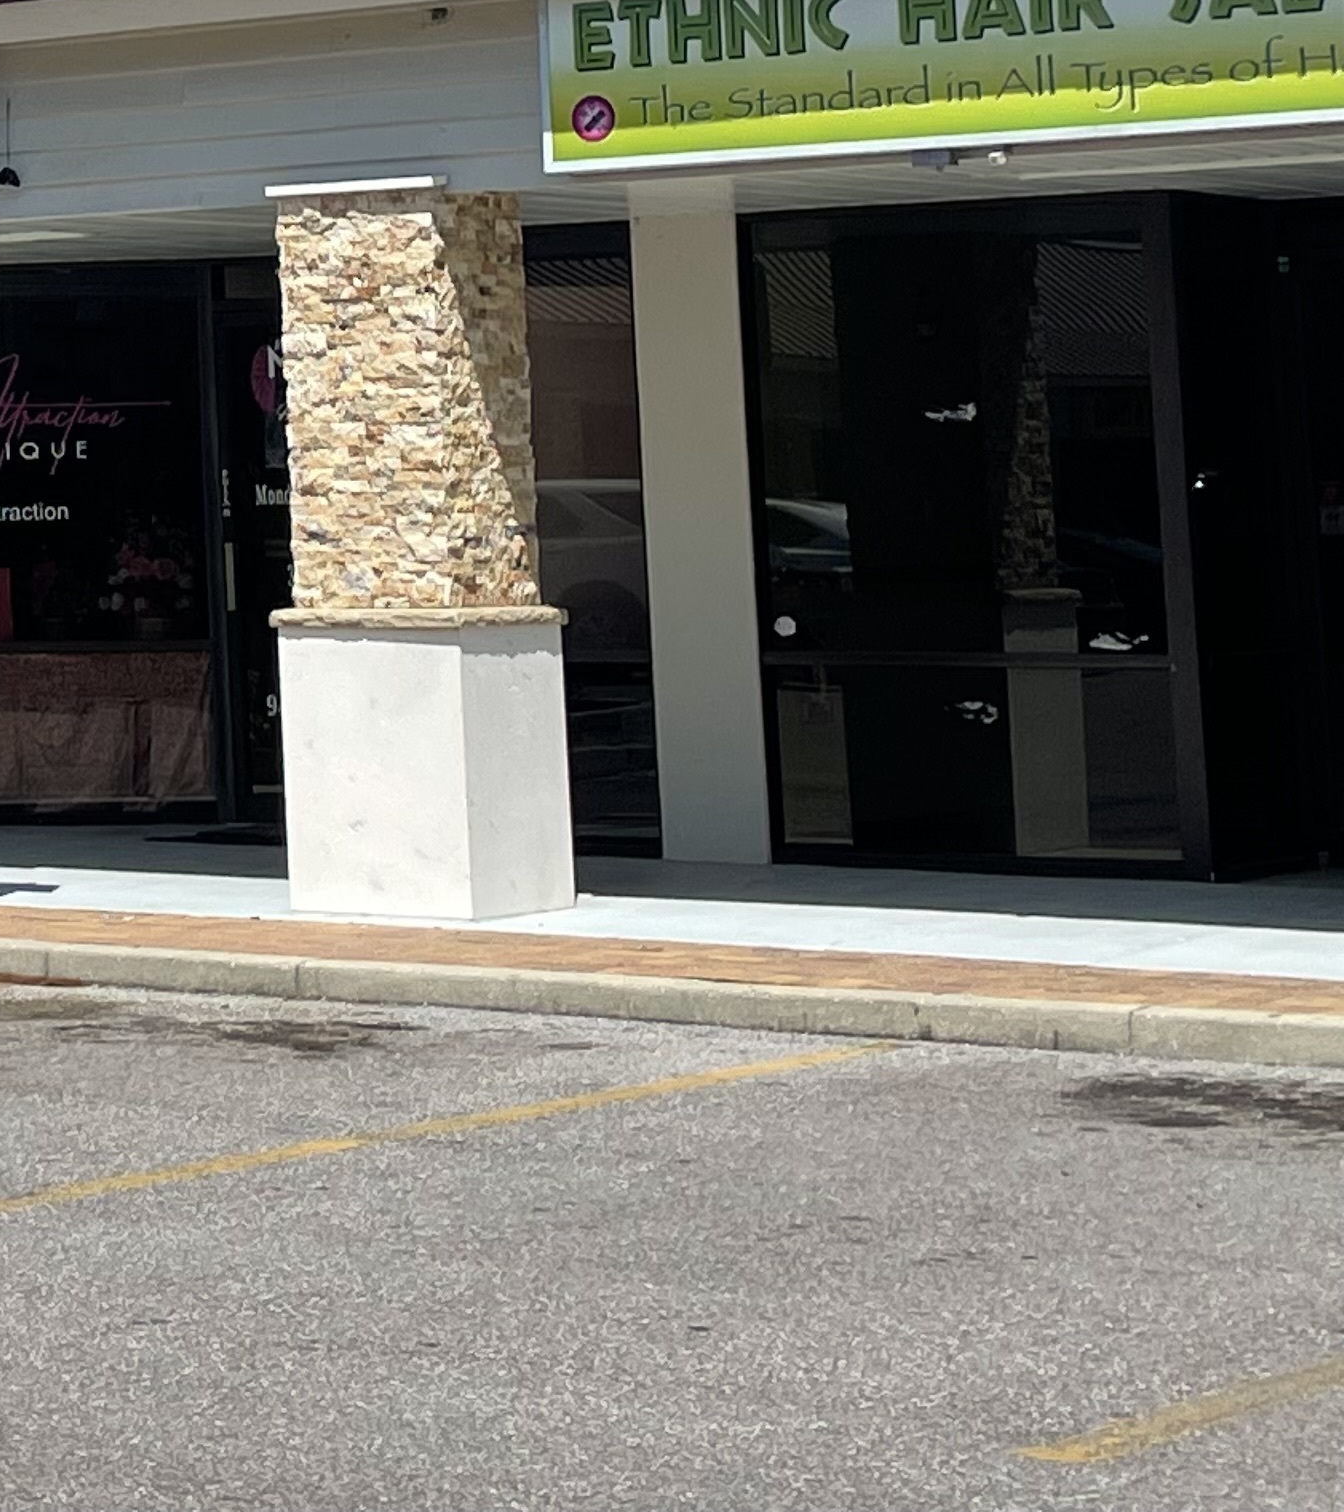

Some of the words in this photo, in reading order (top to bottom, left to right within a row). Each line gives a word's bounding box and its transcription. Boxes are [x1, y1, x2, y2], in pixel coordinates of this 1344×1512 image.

[630, 84, 711, 126] The
[722, 62, 931, 119] Standard
[946, 69, 982, 103] in
[994, 55, 1054, 100] All
[1070, 60, 1211, 114] Types
[1228, 33, 1285, 79] of
